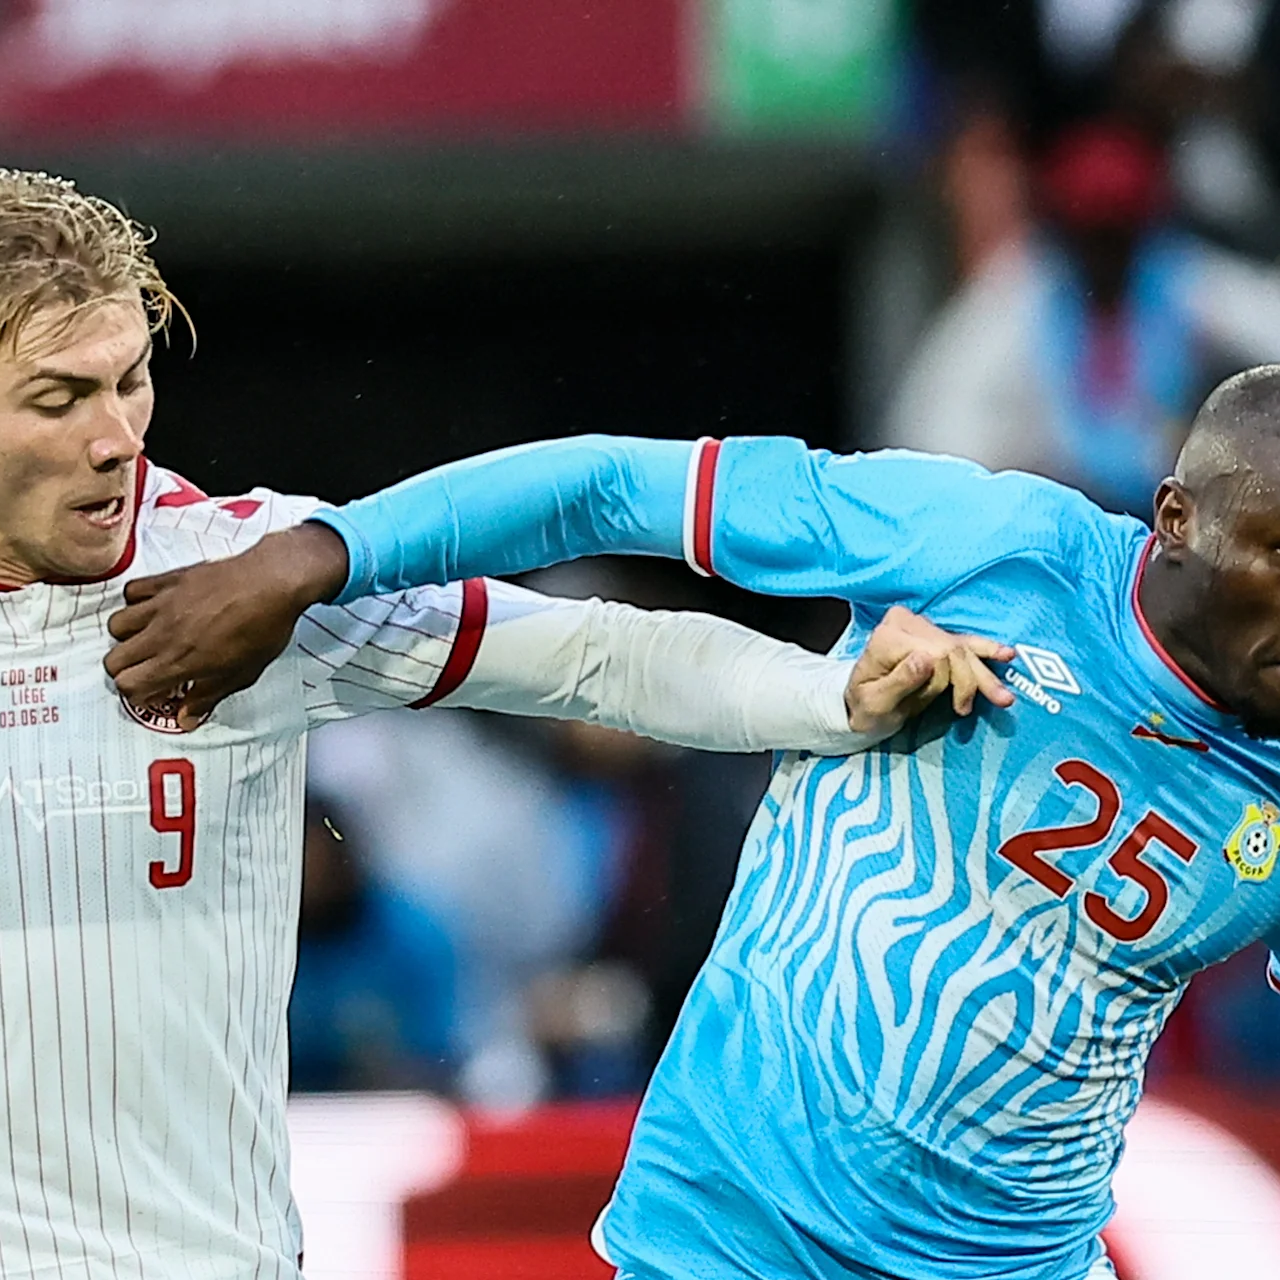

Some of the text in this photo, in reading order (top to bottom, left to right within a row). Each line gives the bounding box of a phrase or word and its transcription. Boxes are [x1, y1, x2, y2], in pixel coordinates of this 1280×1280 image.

[11, 687, 46, 706] LIÈGE
[1004, 667, 1061, 715] umbro
[0, 706, 60, 728] 03.06.26
[147, 757, 196, 890] 9
[996, 758, 1199, 942] 25
